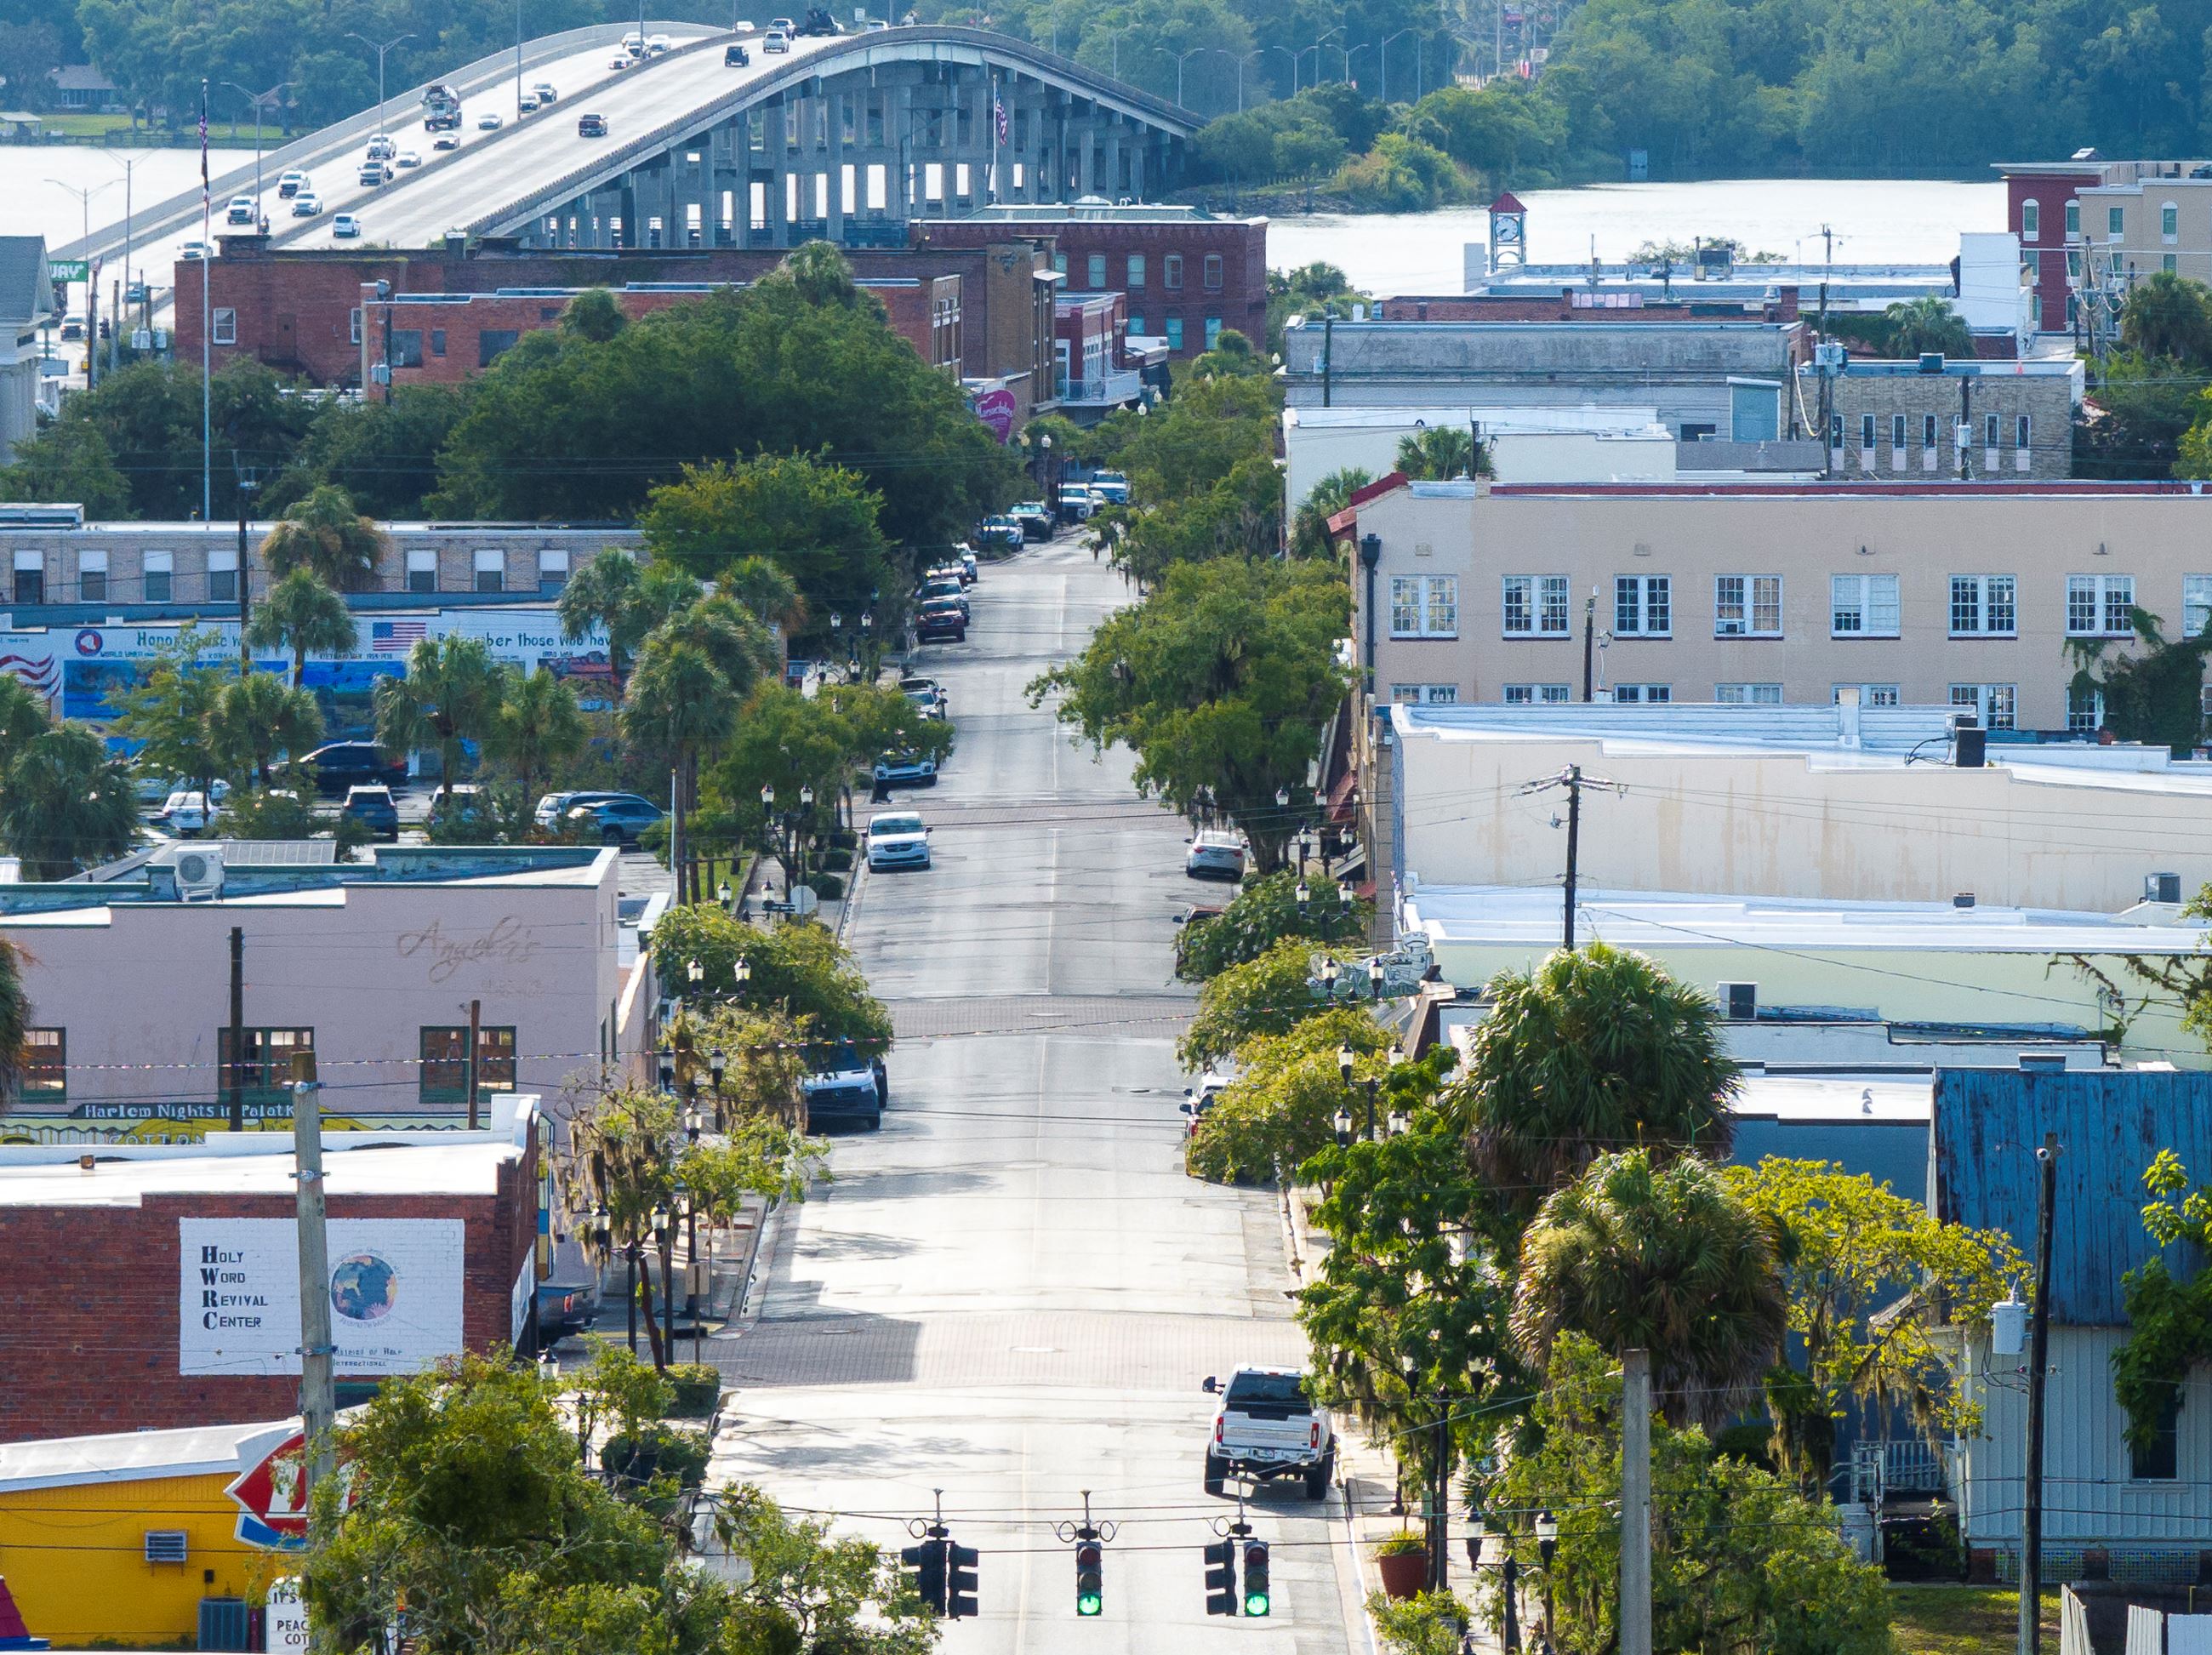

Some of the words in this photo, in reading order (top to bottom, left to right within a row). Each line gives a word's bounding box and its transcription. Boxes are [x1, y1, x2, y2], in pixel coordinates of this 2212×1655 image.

[590, 630, 612, 646] hav
[84, 1104, 151, 1118] Harlem
[157, 1104, 214, 1121] Nights
[242, 1104, 295, 1117] Palatk
[276, 1619, 310, 1631] PEAC
[284, 1633, 309, 1646] COT
